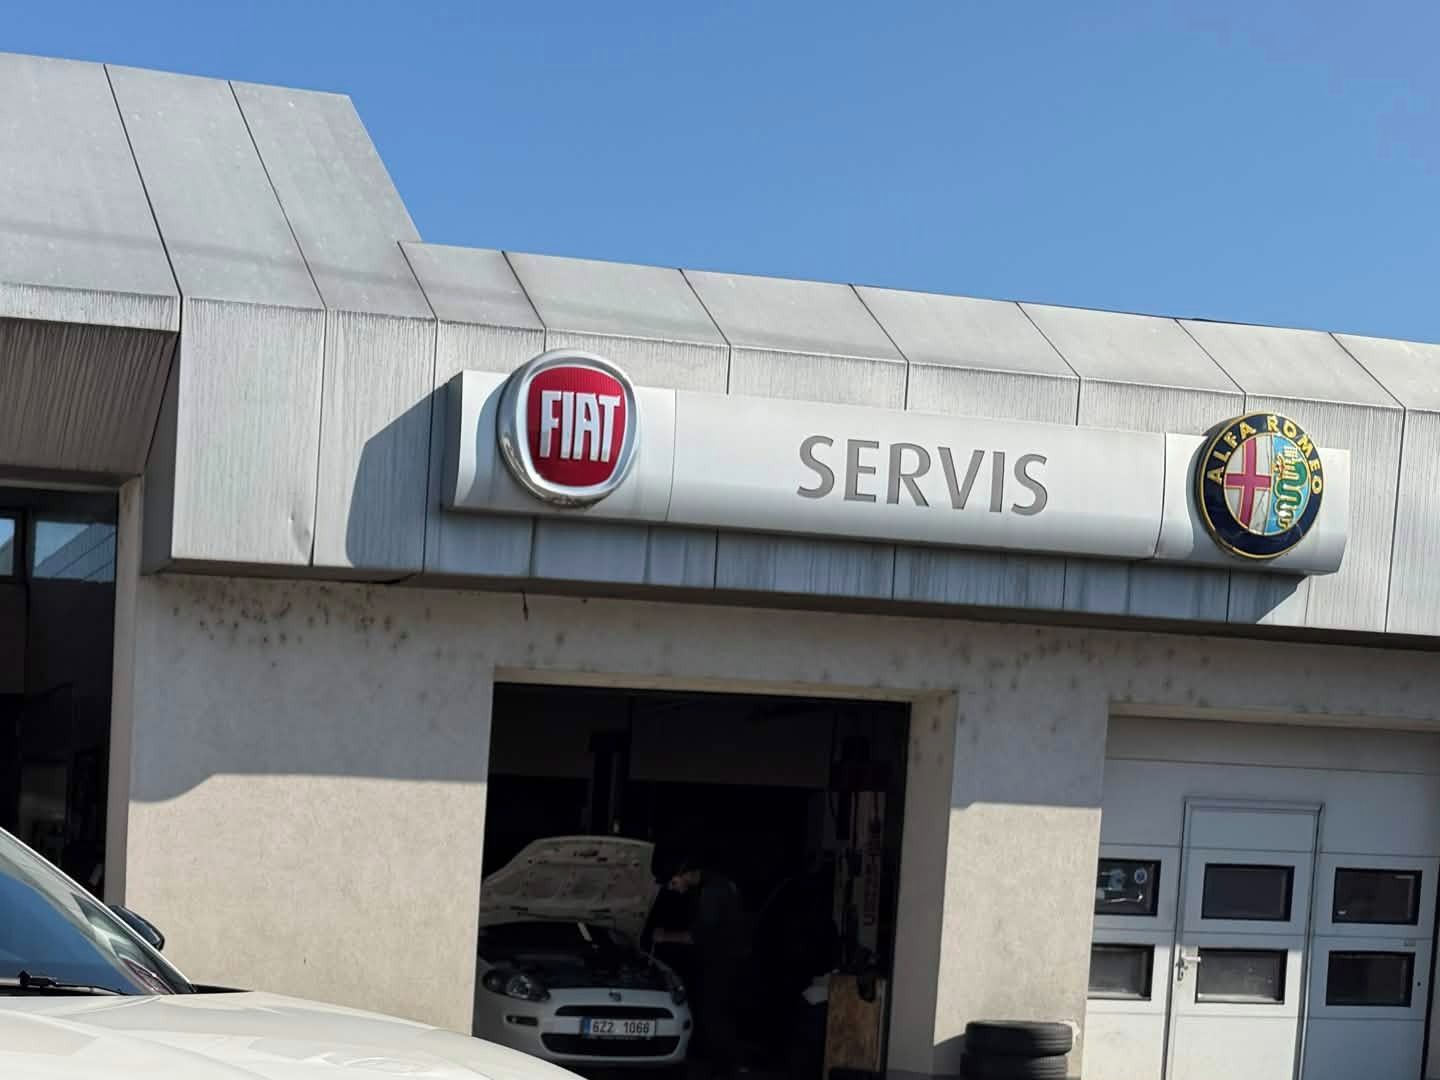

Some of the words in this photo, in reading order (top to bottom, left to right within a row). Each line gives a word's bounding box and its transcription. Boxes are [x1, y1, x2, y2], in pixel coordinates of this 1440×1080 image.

[540, 390, 620, 463] FIAT
[1208, 422, 1257, 484] ALFA
[1267, 416, 1323, 494] ROMEO
[796, 435, 1048, 516] SERVIS
